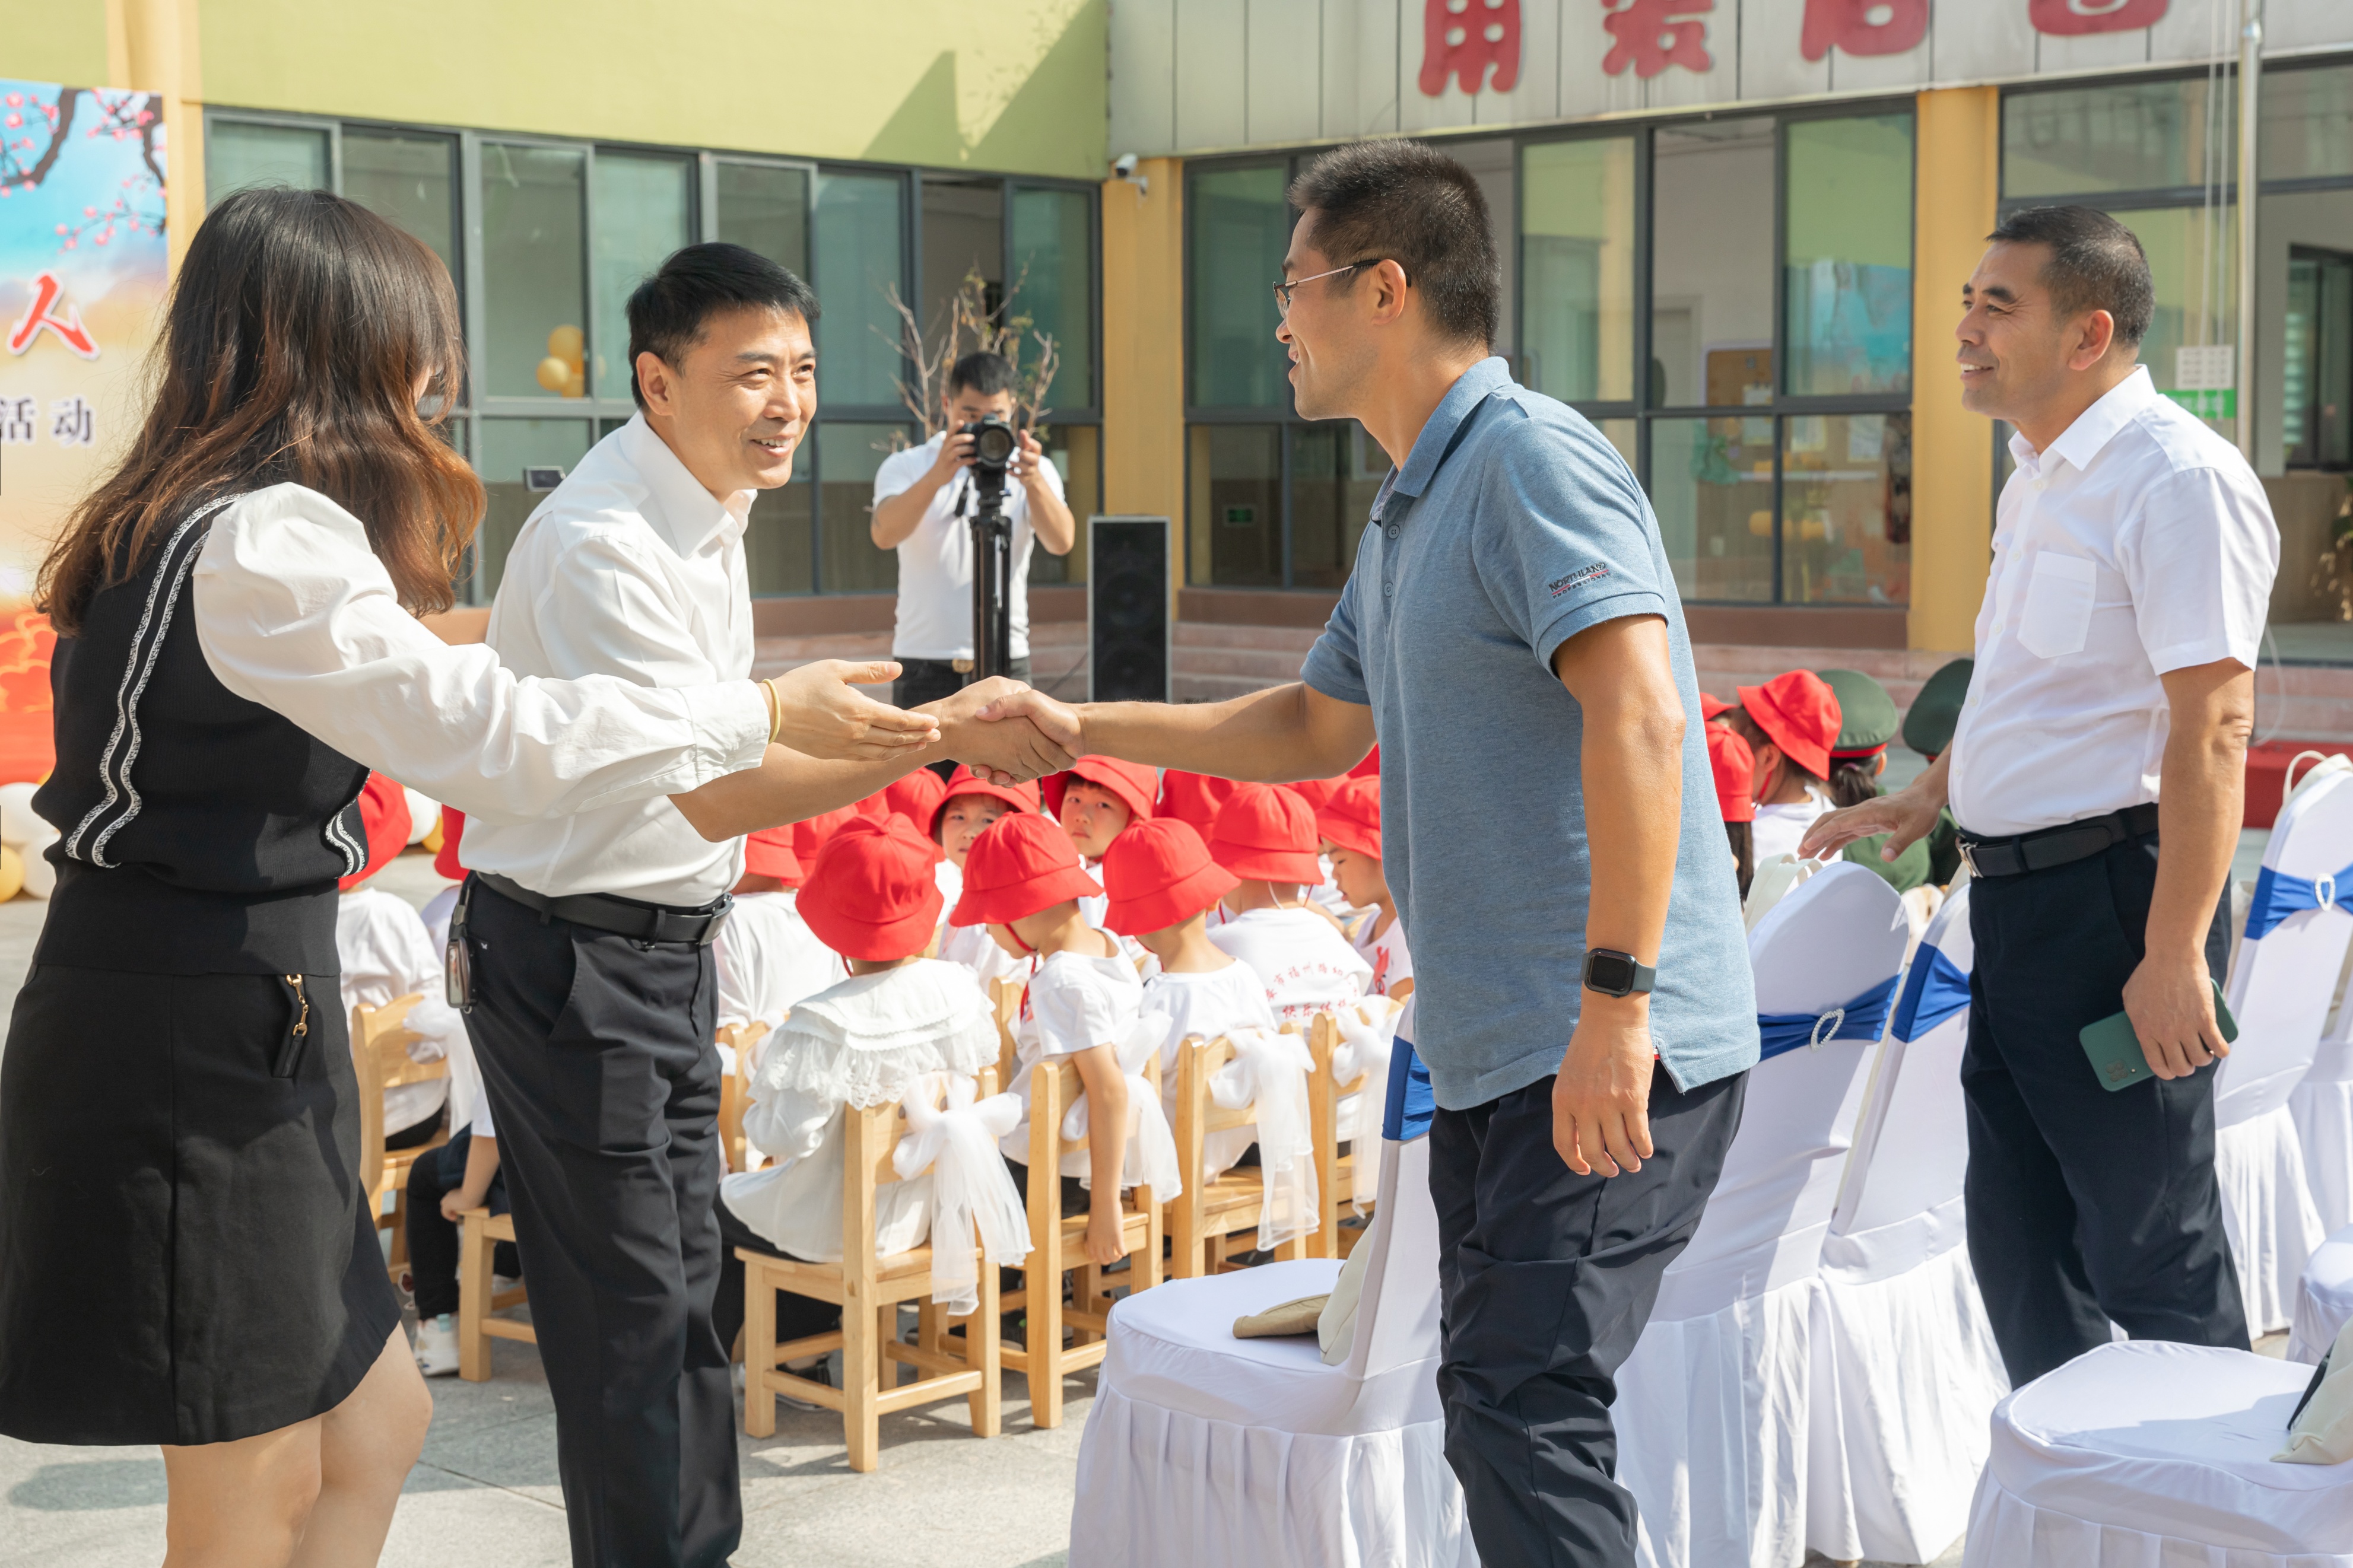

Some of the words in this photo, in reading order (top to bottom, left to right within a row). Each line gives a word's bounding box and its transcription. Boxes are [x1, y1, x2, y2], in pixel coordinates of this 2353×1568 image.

[1418, 0, 2170, 97] 用爱
[10, 273, 97, 356] 人
[0, 397, 93, 443] 活动
[1548, 562, 1606, 592] NORTHLAND
